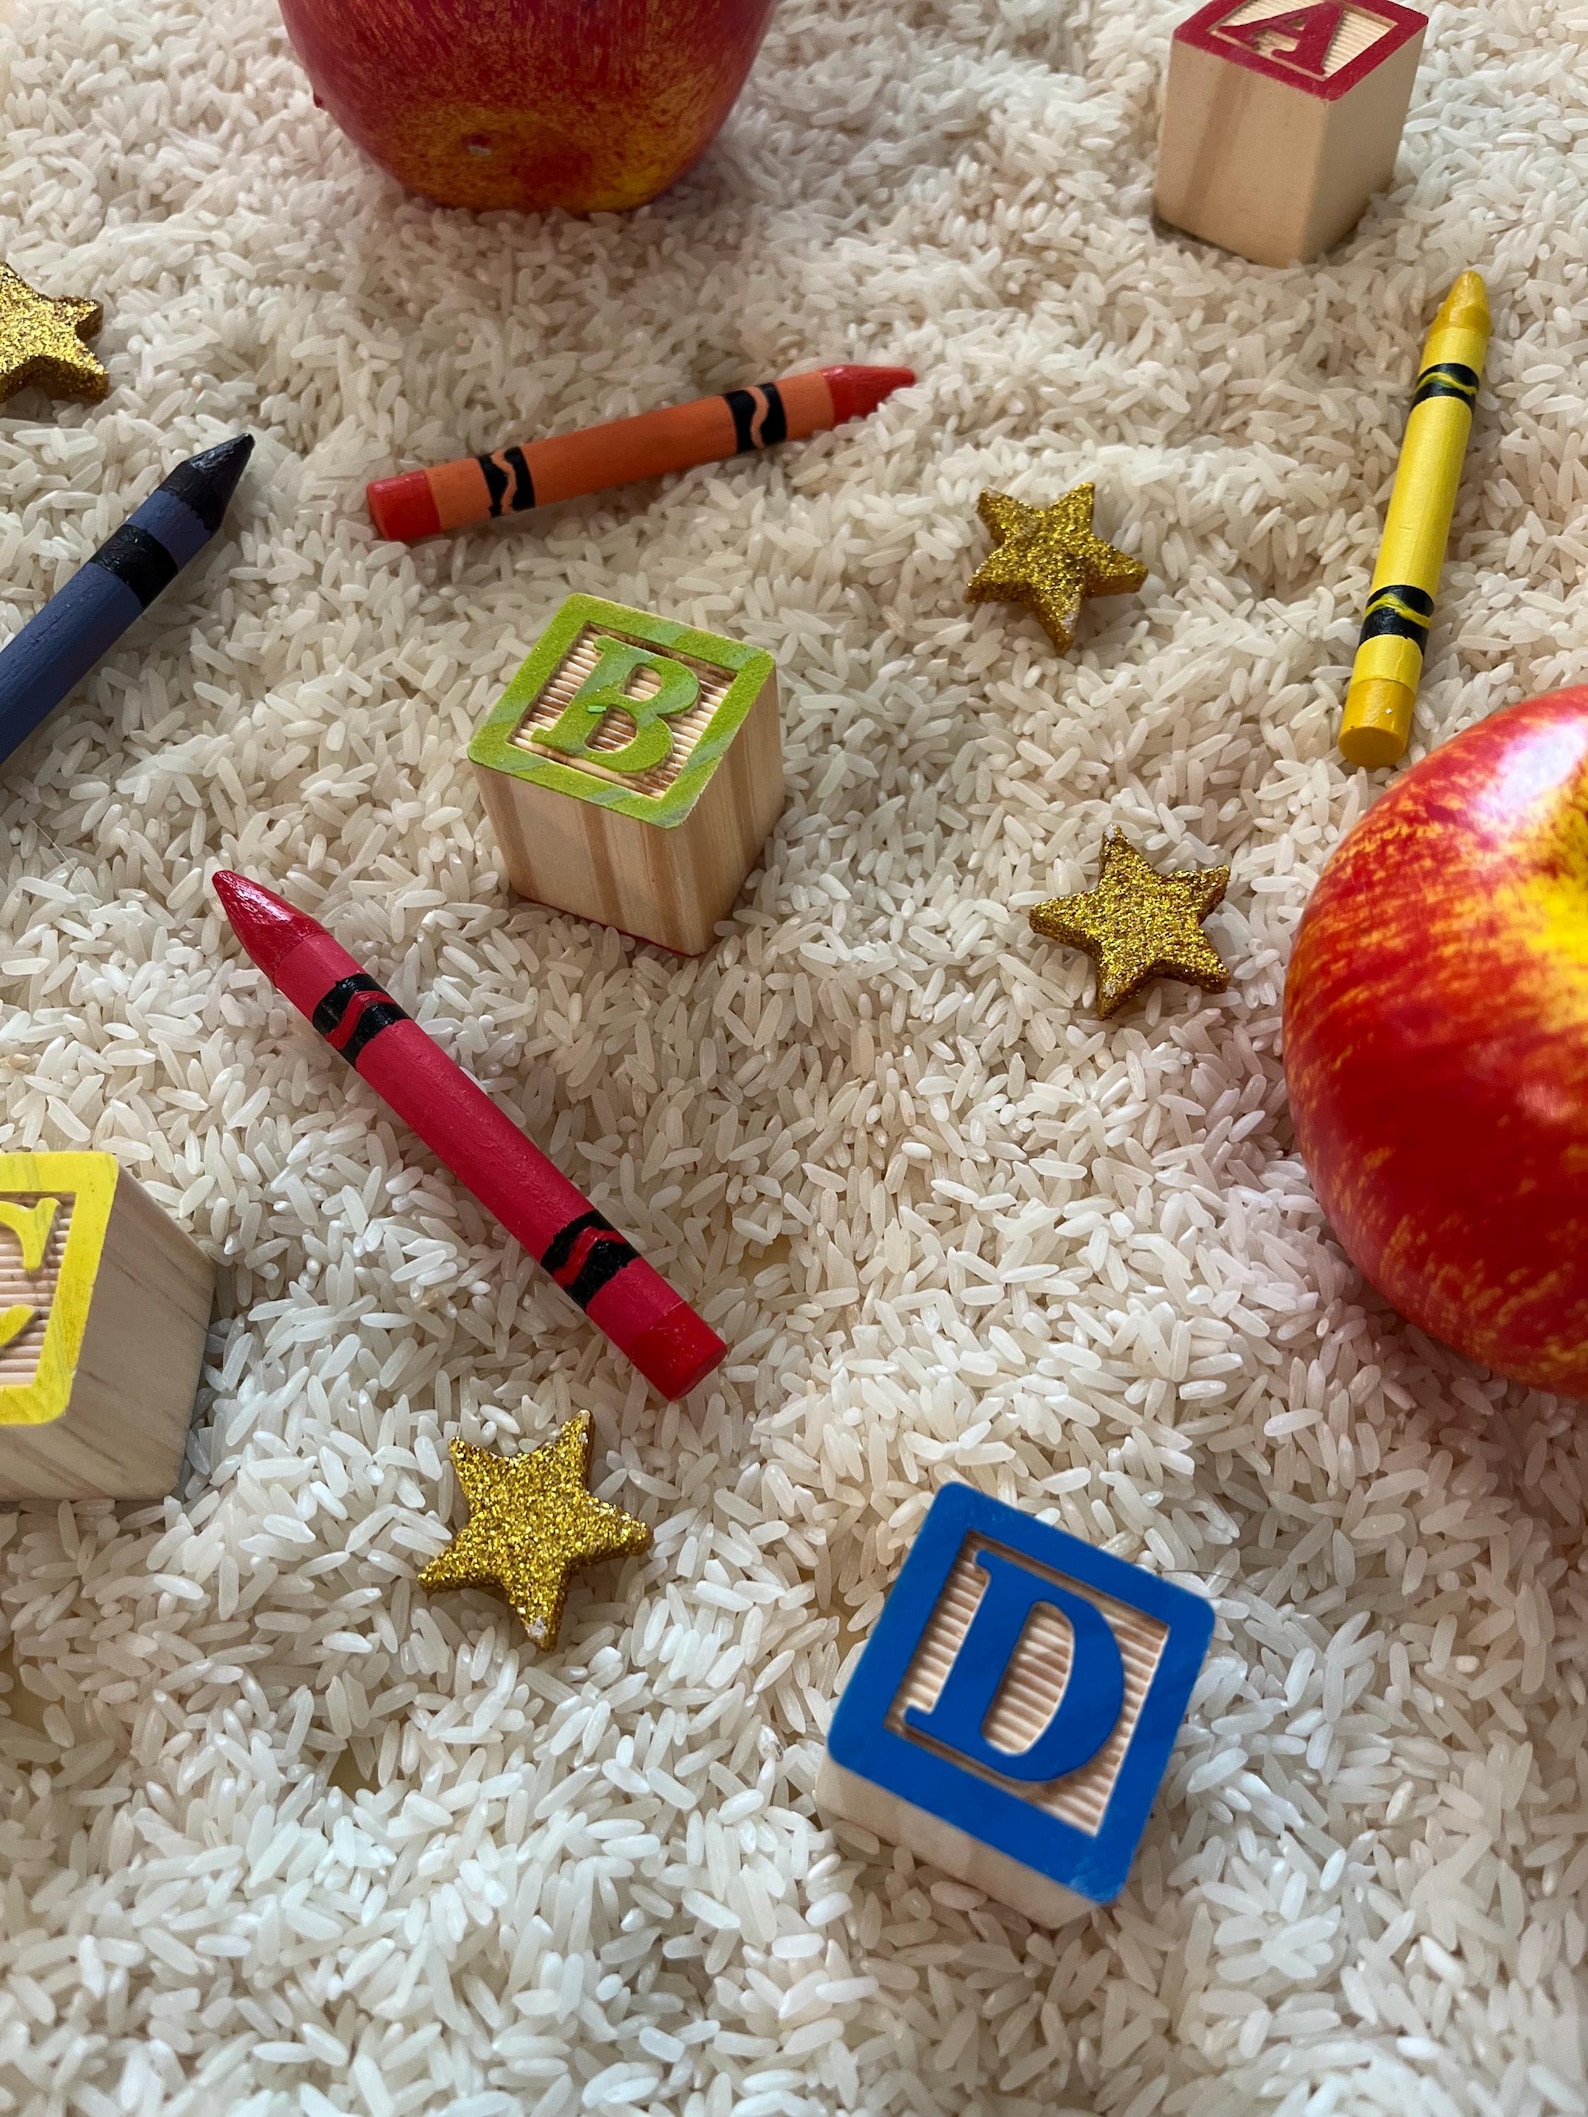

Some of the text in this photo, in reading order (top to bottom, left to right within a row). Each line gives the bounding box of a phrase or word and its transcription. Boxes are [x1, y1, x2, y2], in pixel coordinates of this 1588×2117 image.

[1216, 0, 1344, 75] A
[531, 635, 700, 773] B
[903, 1548, 1125, 1782] D
